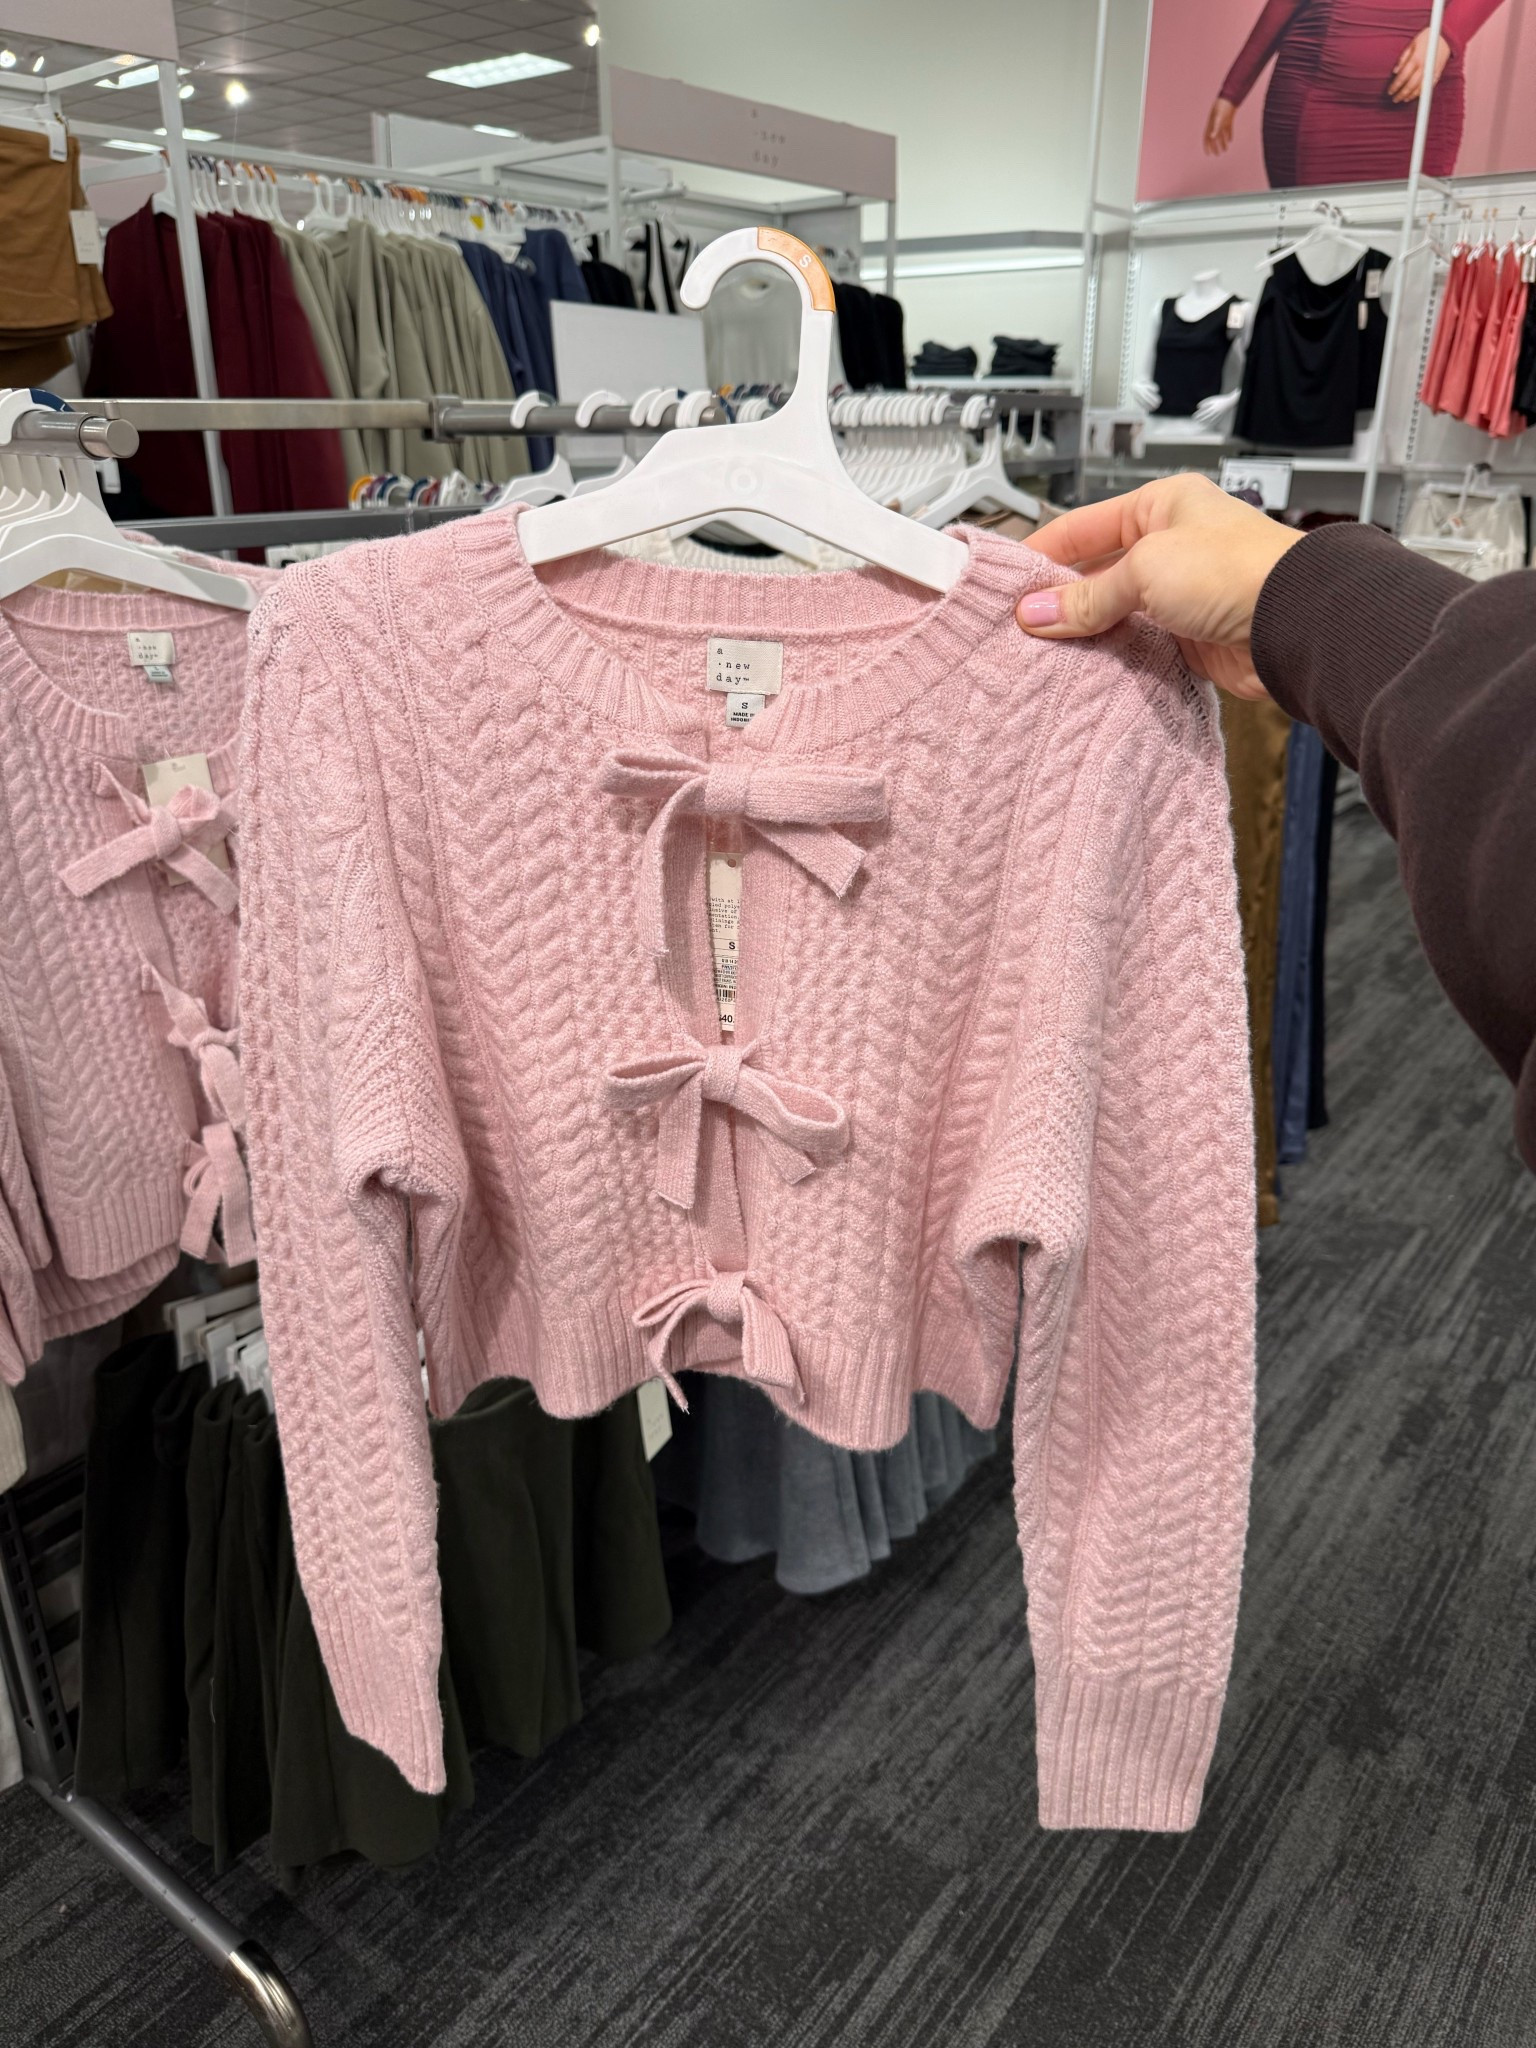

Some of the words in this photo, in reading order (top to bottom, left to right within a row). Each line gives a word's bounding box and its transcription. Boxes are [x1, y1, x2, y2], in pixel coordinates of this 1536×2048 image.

[799, 254, 812, 268] S
[725, 661, 751, 670] new
[741, 701, 749, 710] S
[728, 941, 736, 950] S
